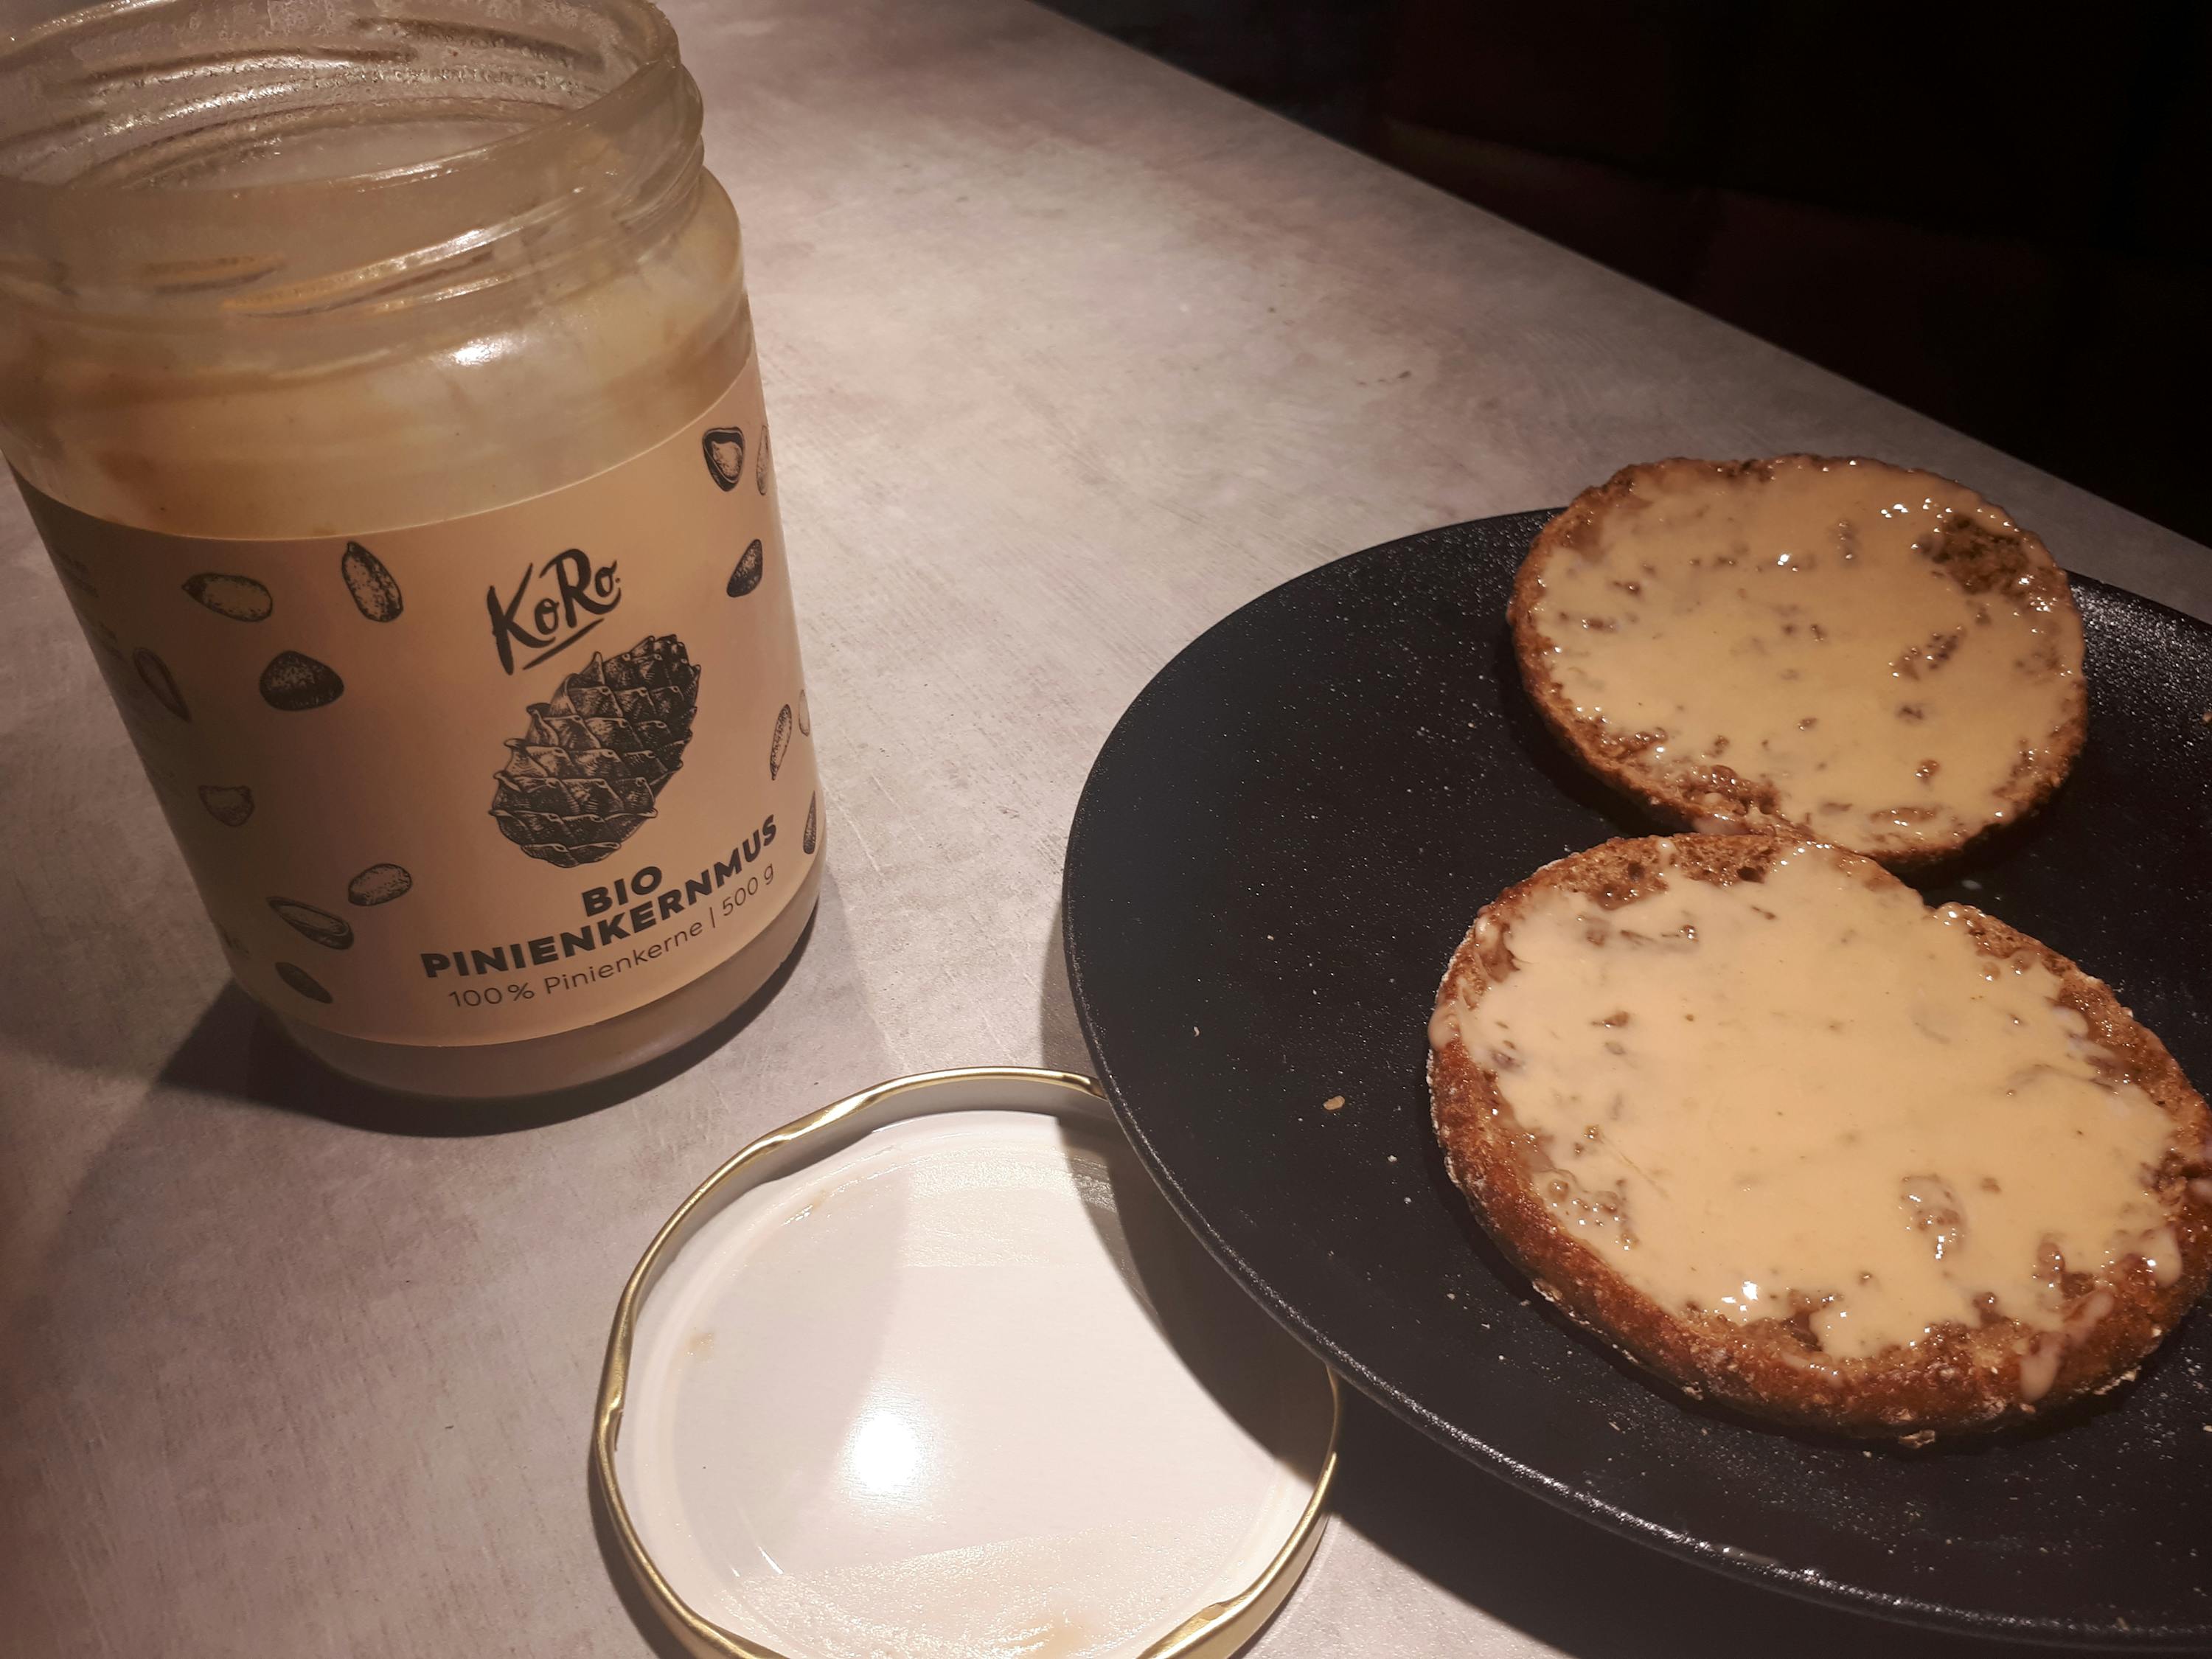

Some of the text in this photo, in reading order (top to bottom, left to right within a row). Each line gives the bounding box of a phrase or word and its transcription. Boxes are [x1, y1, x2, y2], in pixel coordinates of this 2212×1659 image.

[487, 548, 622, 676] KoRo
[421, 815, 776, 978] PINIENKERNMUS
[543, 920, 703, 995] Pinienkerne
[723, 877, 758, 916] 500
[764, 863, 773, 885] g
[580, 865, 663, 917] BIO
